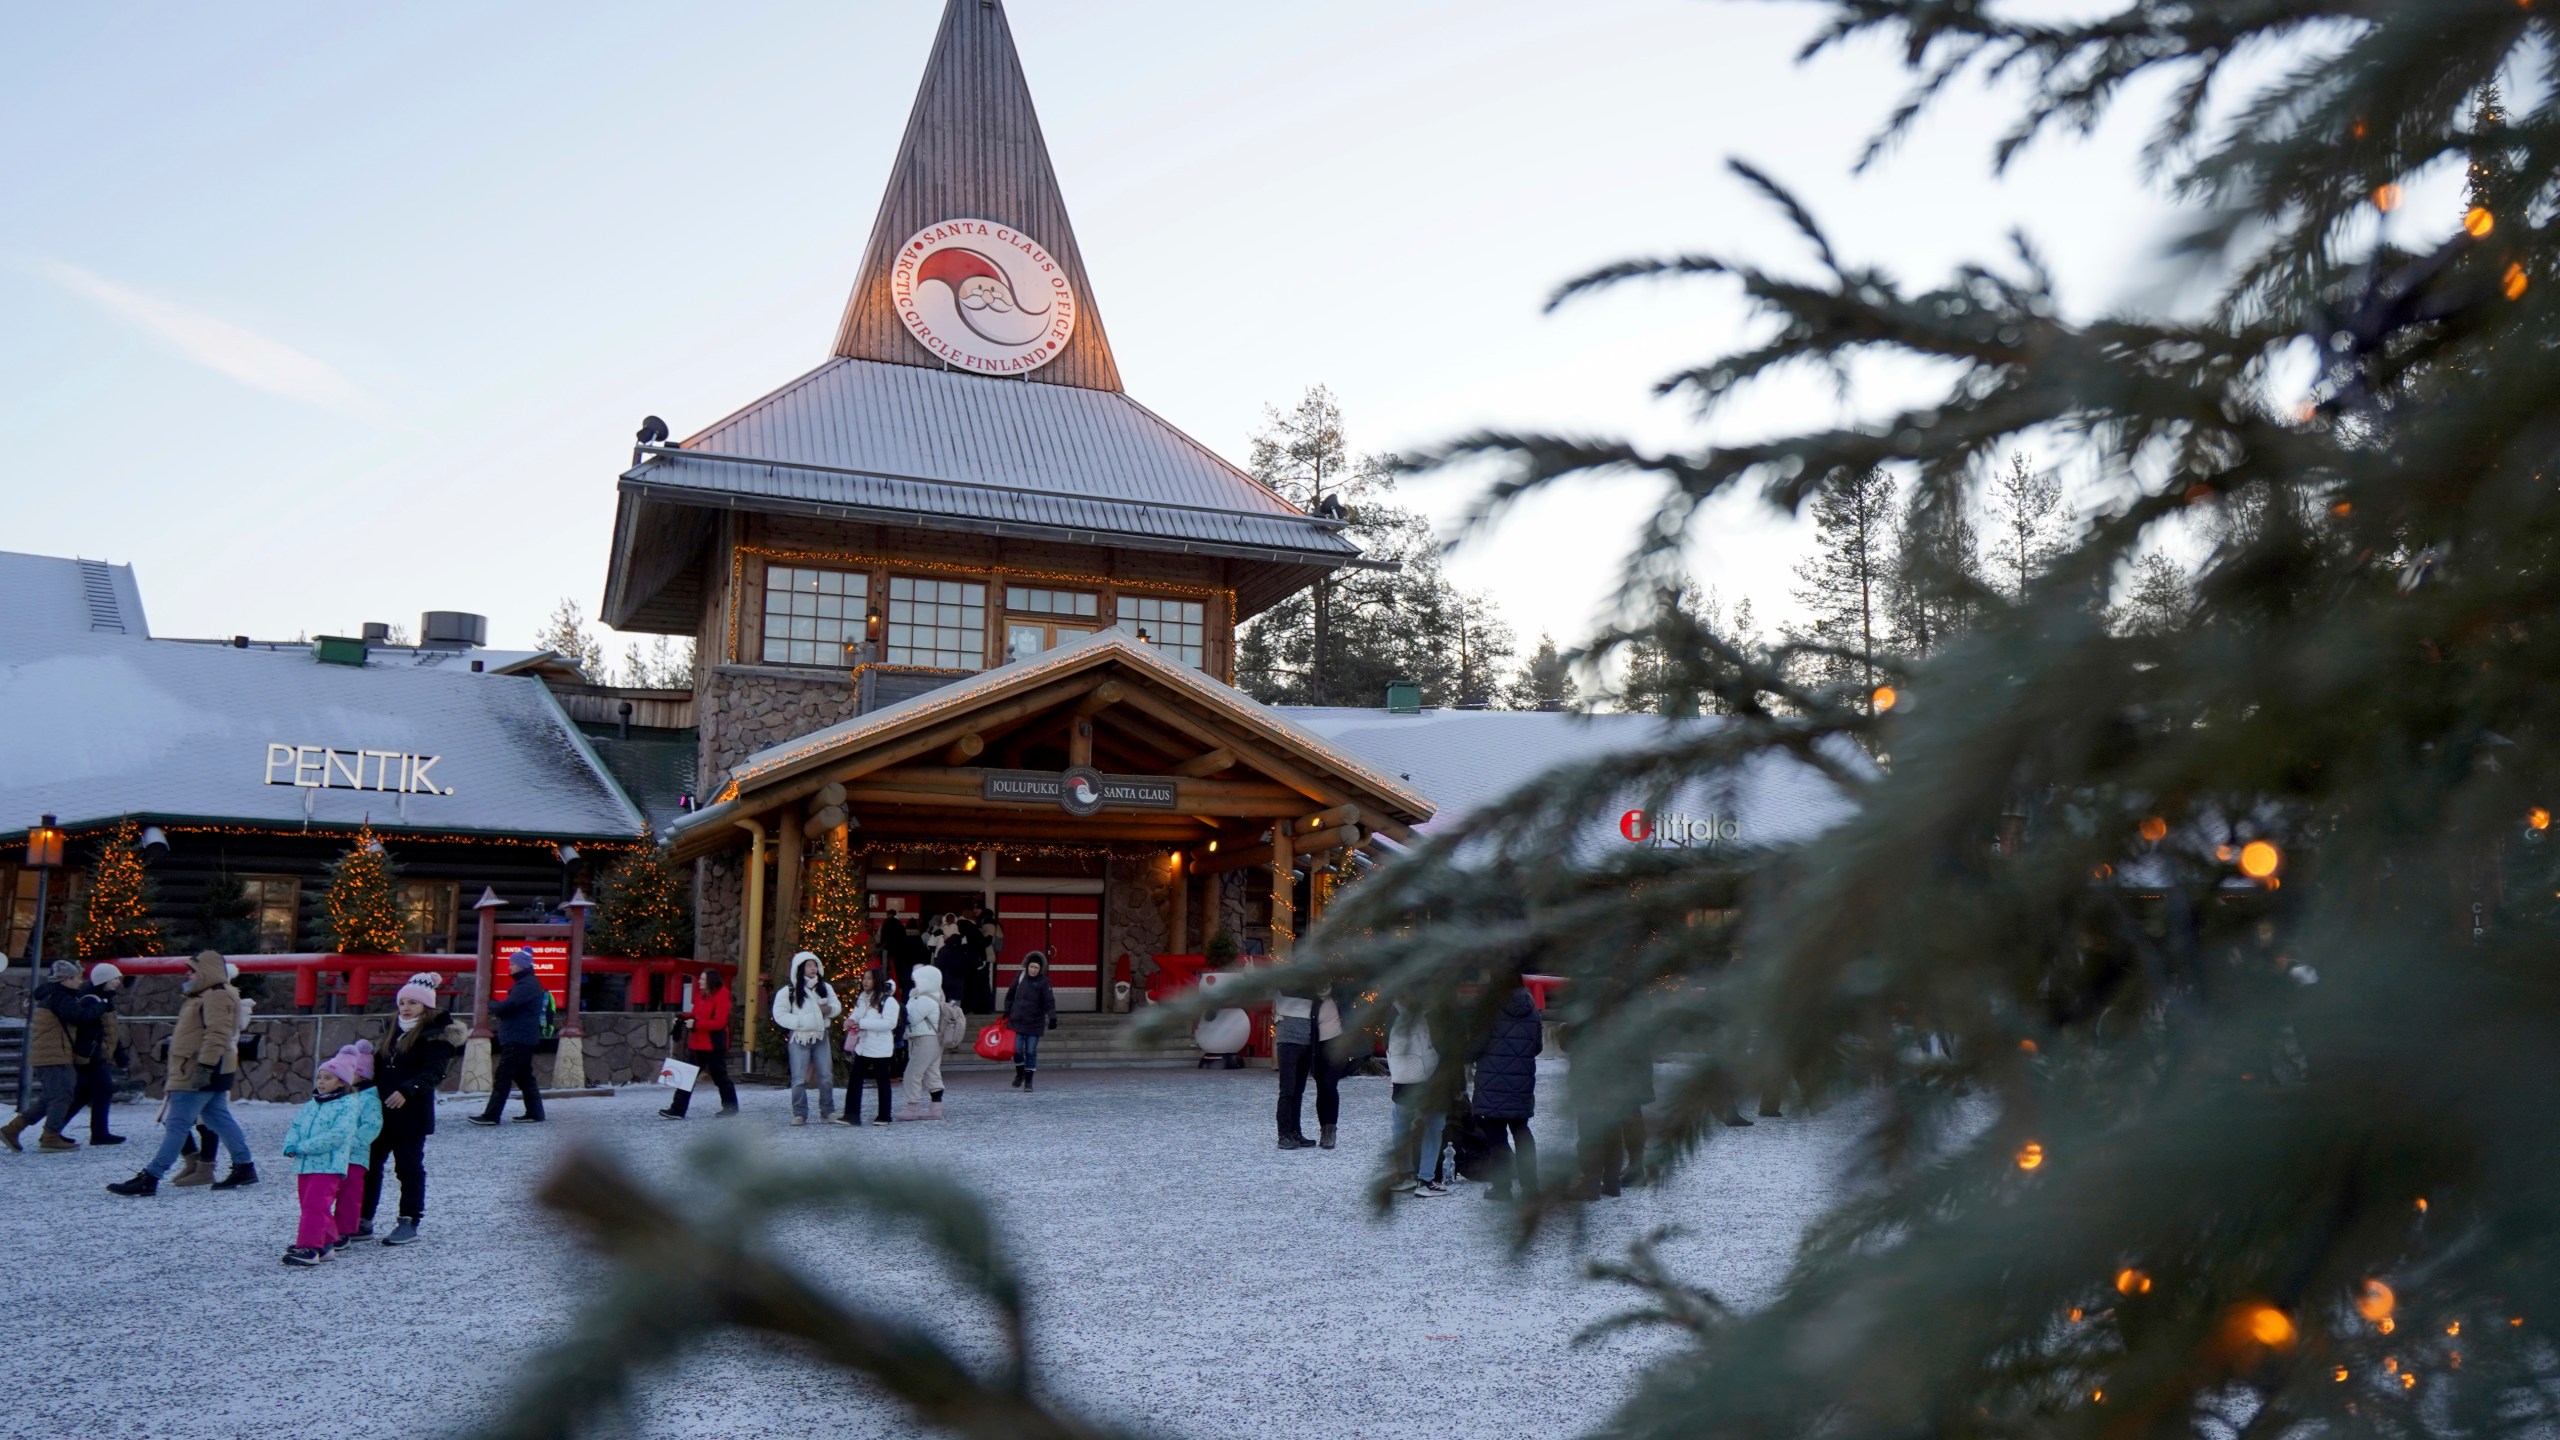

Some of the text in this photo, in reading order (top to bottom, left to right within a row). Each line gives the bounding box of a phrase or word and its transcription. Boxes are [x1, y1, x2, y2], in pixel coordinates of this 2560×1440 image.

[923, 222, 1071, 341] SANTA CLAUS OFFICE
[896, 247, 1048, 372] ARCTIC CIRCLE FINLAND
[264, 743, 454, 796] PENTIK.
[992, 780, 1059, 795] JOULUPUKKI
[1103, 786, 1171, 801] SANTA CLAUS
[1655, 813, 1740, 840] iittala
